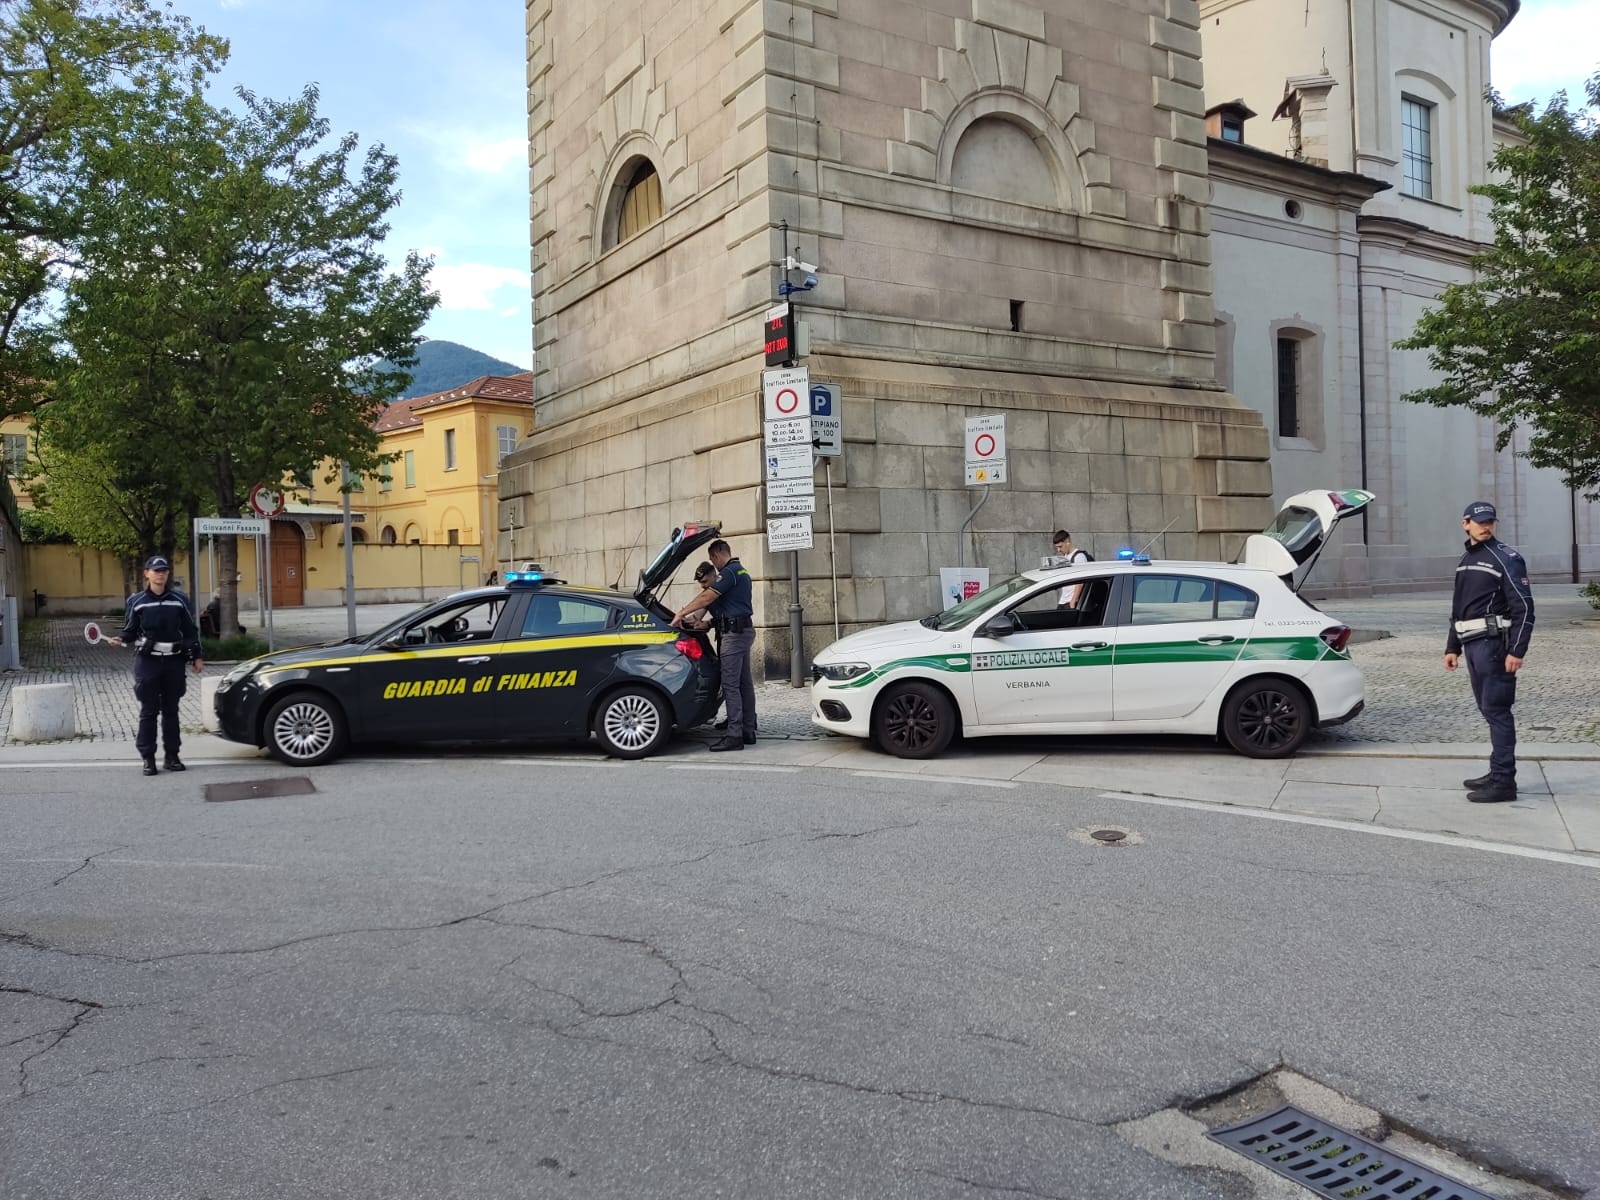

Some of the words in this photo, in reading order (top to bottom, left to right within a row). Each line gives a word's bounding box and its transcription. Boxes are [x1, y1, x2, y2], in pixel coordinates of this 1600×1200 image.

[771, 317, 783, 330] ZTL
[814, 395, 827, 411] P
[202, 523, 234, 531] Giovanni
[630, 614, 649, 622] 117
[990, 652, 1027, 667] POLIZIA
[1029, 650, 1067, 665] LOCALE
[384, 678, 466, 699] GUARDIA
[472, 676, 494, 693] di
[496, 670, 577, 692] FINANZA
[1006, 680, 1051, 689] VERBANIA
